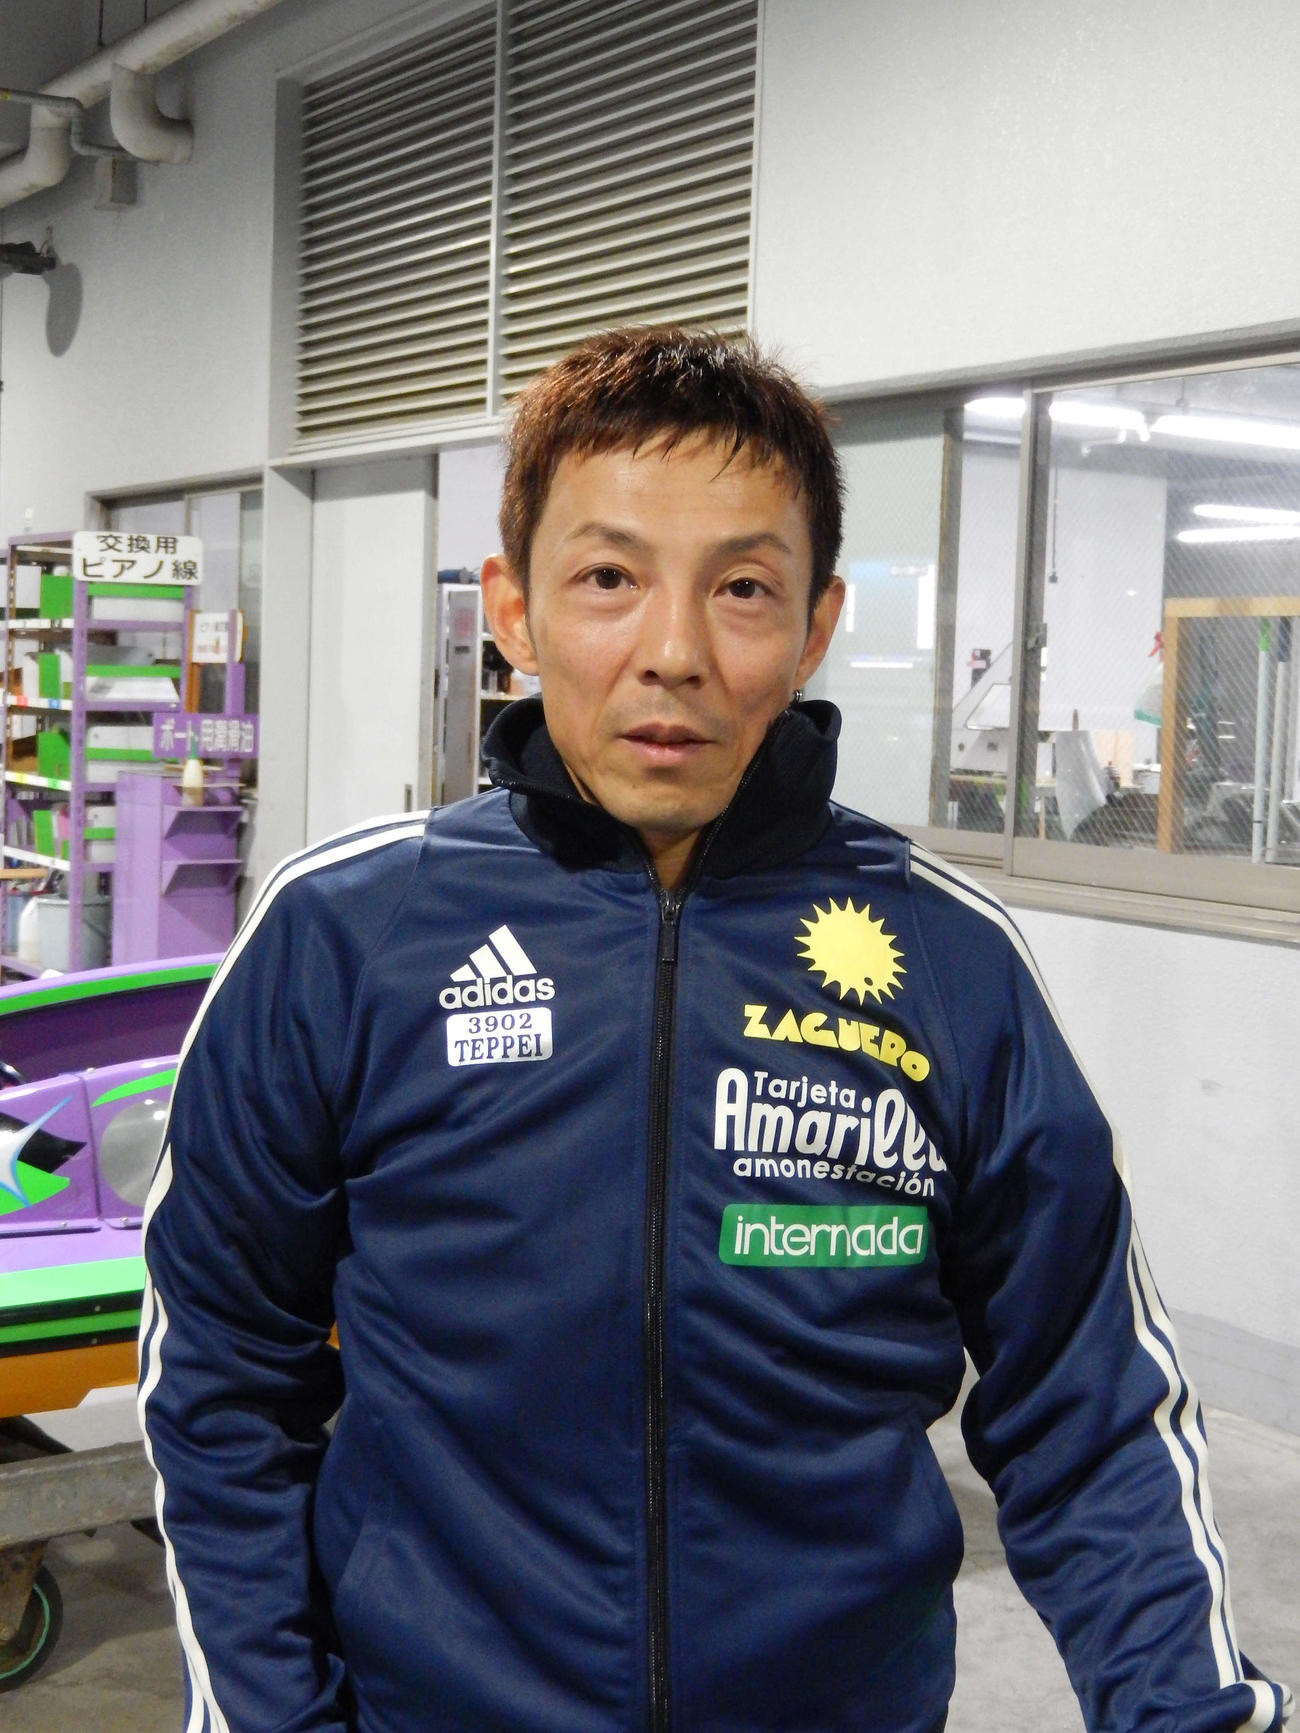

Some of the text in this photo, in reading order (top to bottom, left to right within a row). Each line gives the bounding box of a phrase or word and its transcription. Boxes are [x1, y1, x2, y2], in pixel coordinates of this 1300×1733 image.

[96, 534, 178, 554] 交換用
[82, 557, 198, 580] ピアノ線
[439, 975, 556, 1010] adidas
[468, 1012, 532, 1034] 3902
[454, 1033, 543, 1063] TEPPEI
[754, 1071, 856, 1109] Tarjeta
[733, 1156, 935, 1196] amonestación
[734, 1215, 923, 1256] internada
